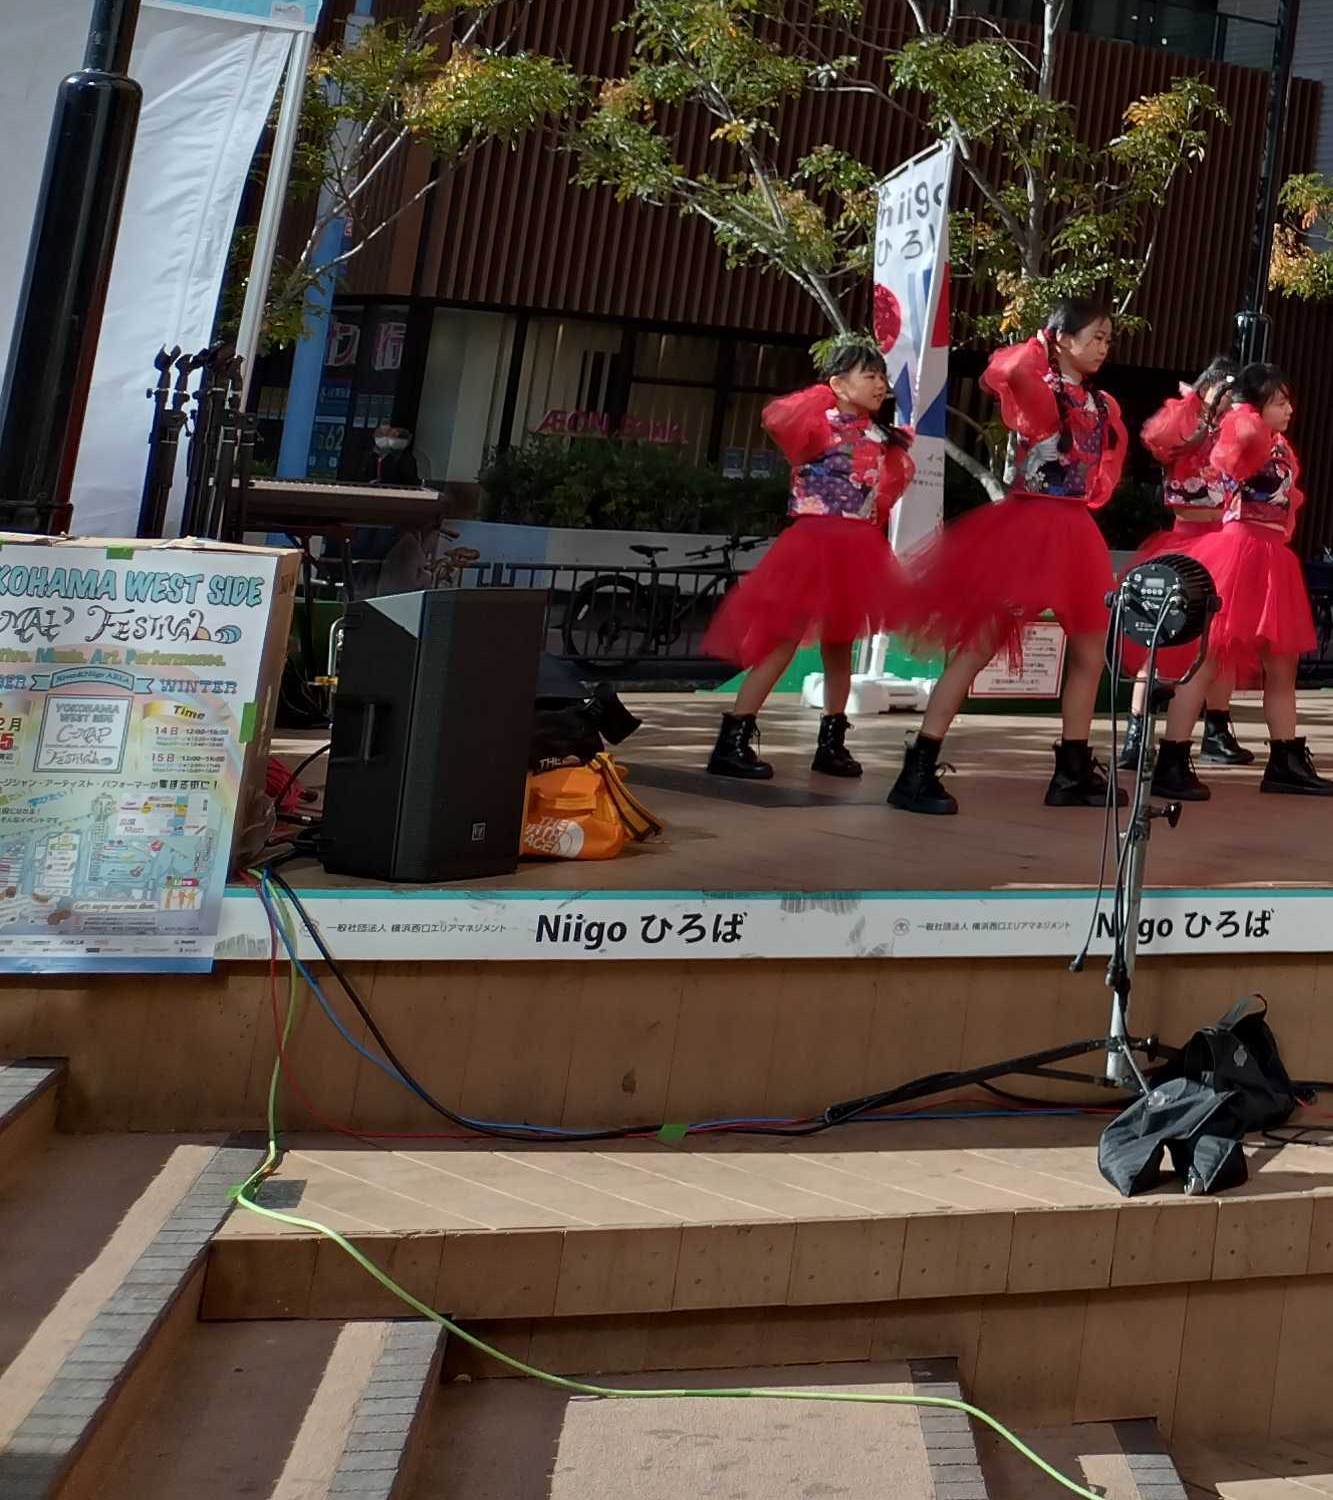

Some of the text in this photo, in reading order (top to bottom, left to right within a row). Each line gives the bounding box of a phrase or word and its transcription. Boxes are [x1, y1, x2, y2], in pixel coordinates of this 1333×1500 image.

[125, 570, 205, 604] WEST
[206, 575, 265, 607] SIDE
[159, 678, 239, 695] WINTER
[173, 705, 206, 720] Time
[155, 726, 178, 736] 14日
[152, 753, 175, 763] 15日
[326, 911, 748, 951] 一般社団法人 横浜西口エリアマネジメント Niigo ひろば
[916, 921, 969, 932] 一般社団法人
[1096, 911, 1173, 944] Ngo
[1183, 908, 1275, 939] ひろば
